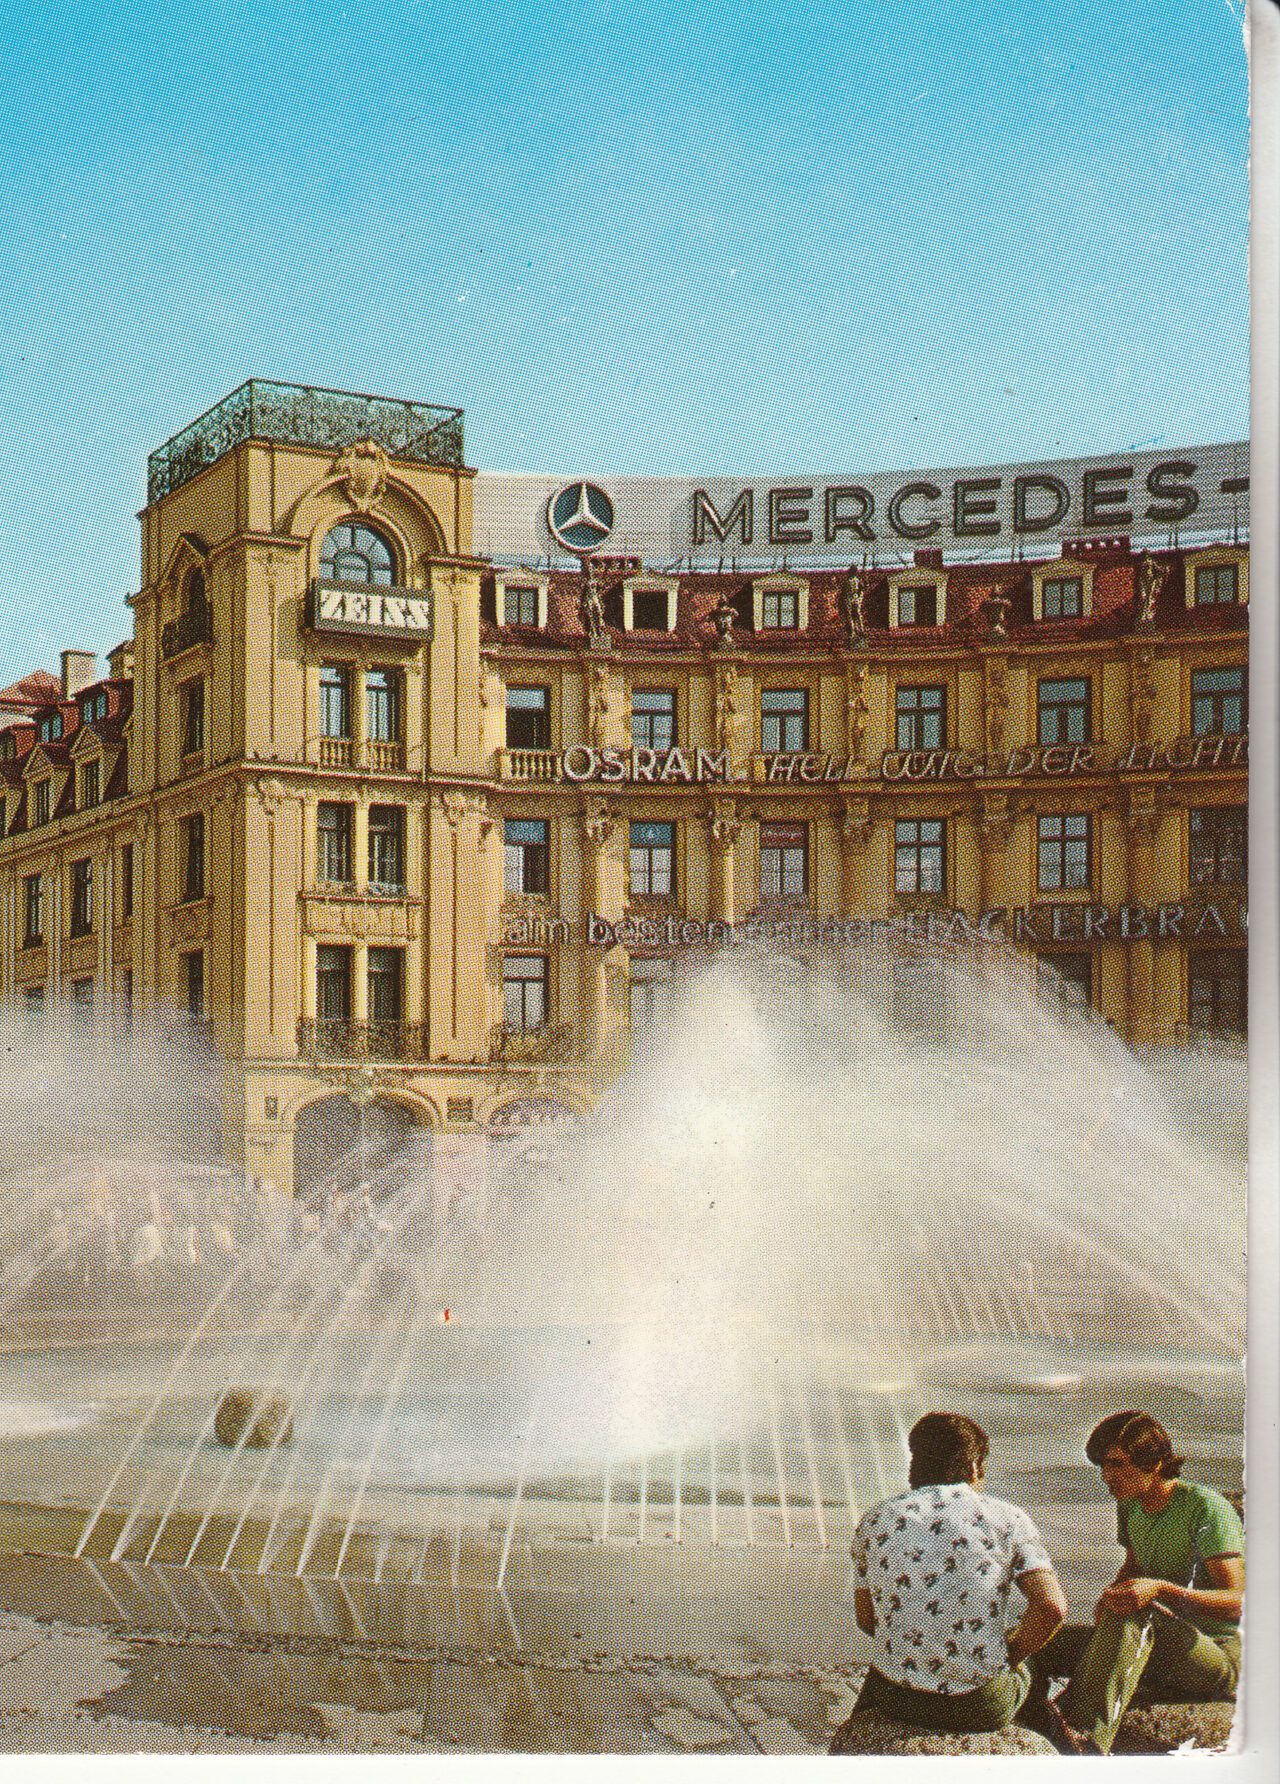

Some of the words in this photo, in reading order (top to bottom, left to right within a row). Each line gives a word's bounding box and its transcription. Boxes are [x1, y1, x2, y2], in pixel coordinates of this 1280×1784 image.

[320, 589, 429, 630] ZEISS
[563, 747, 733, 783] OSRAM
[902, 904, 1250, 945] HACKERBRA
